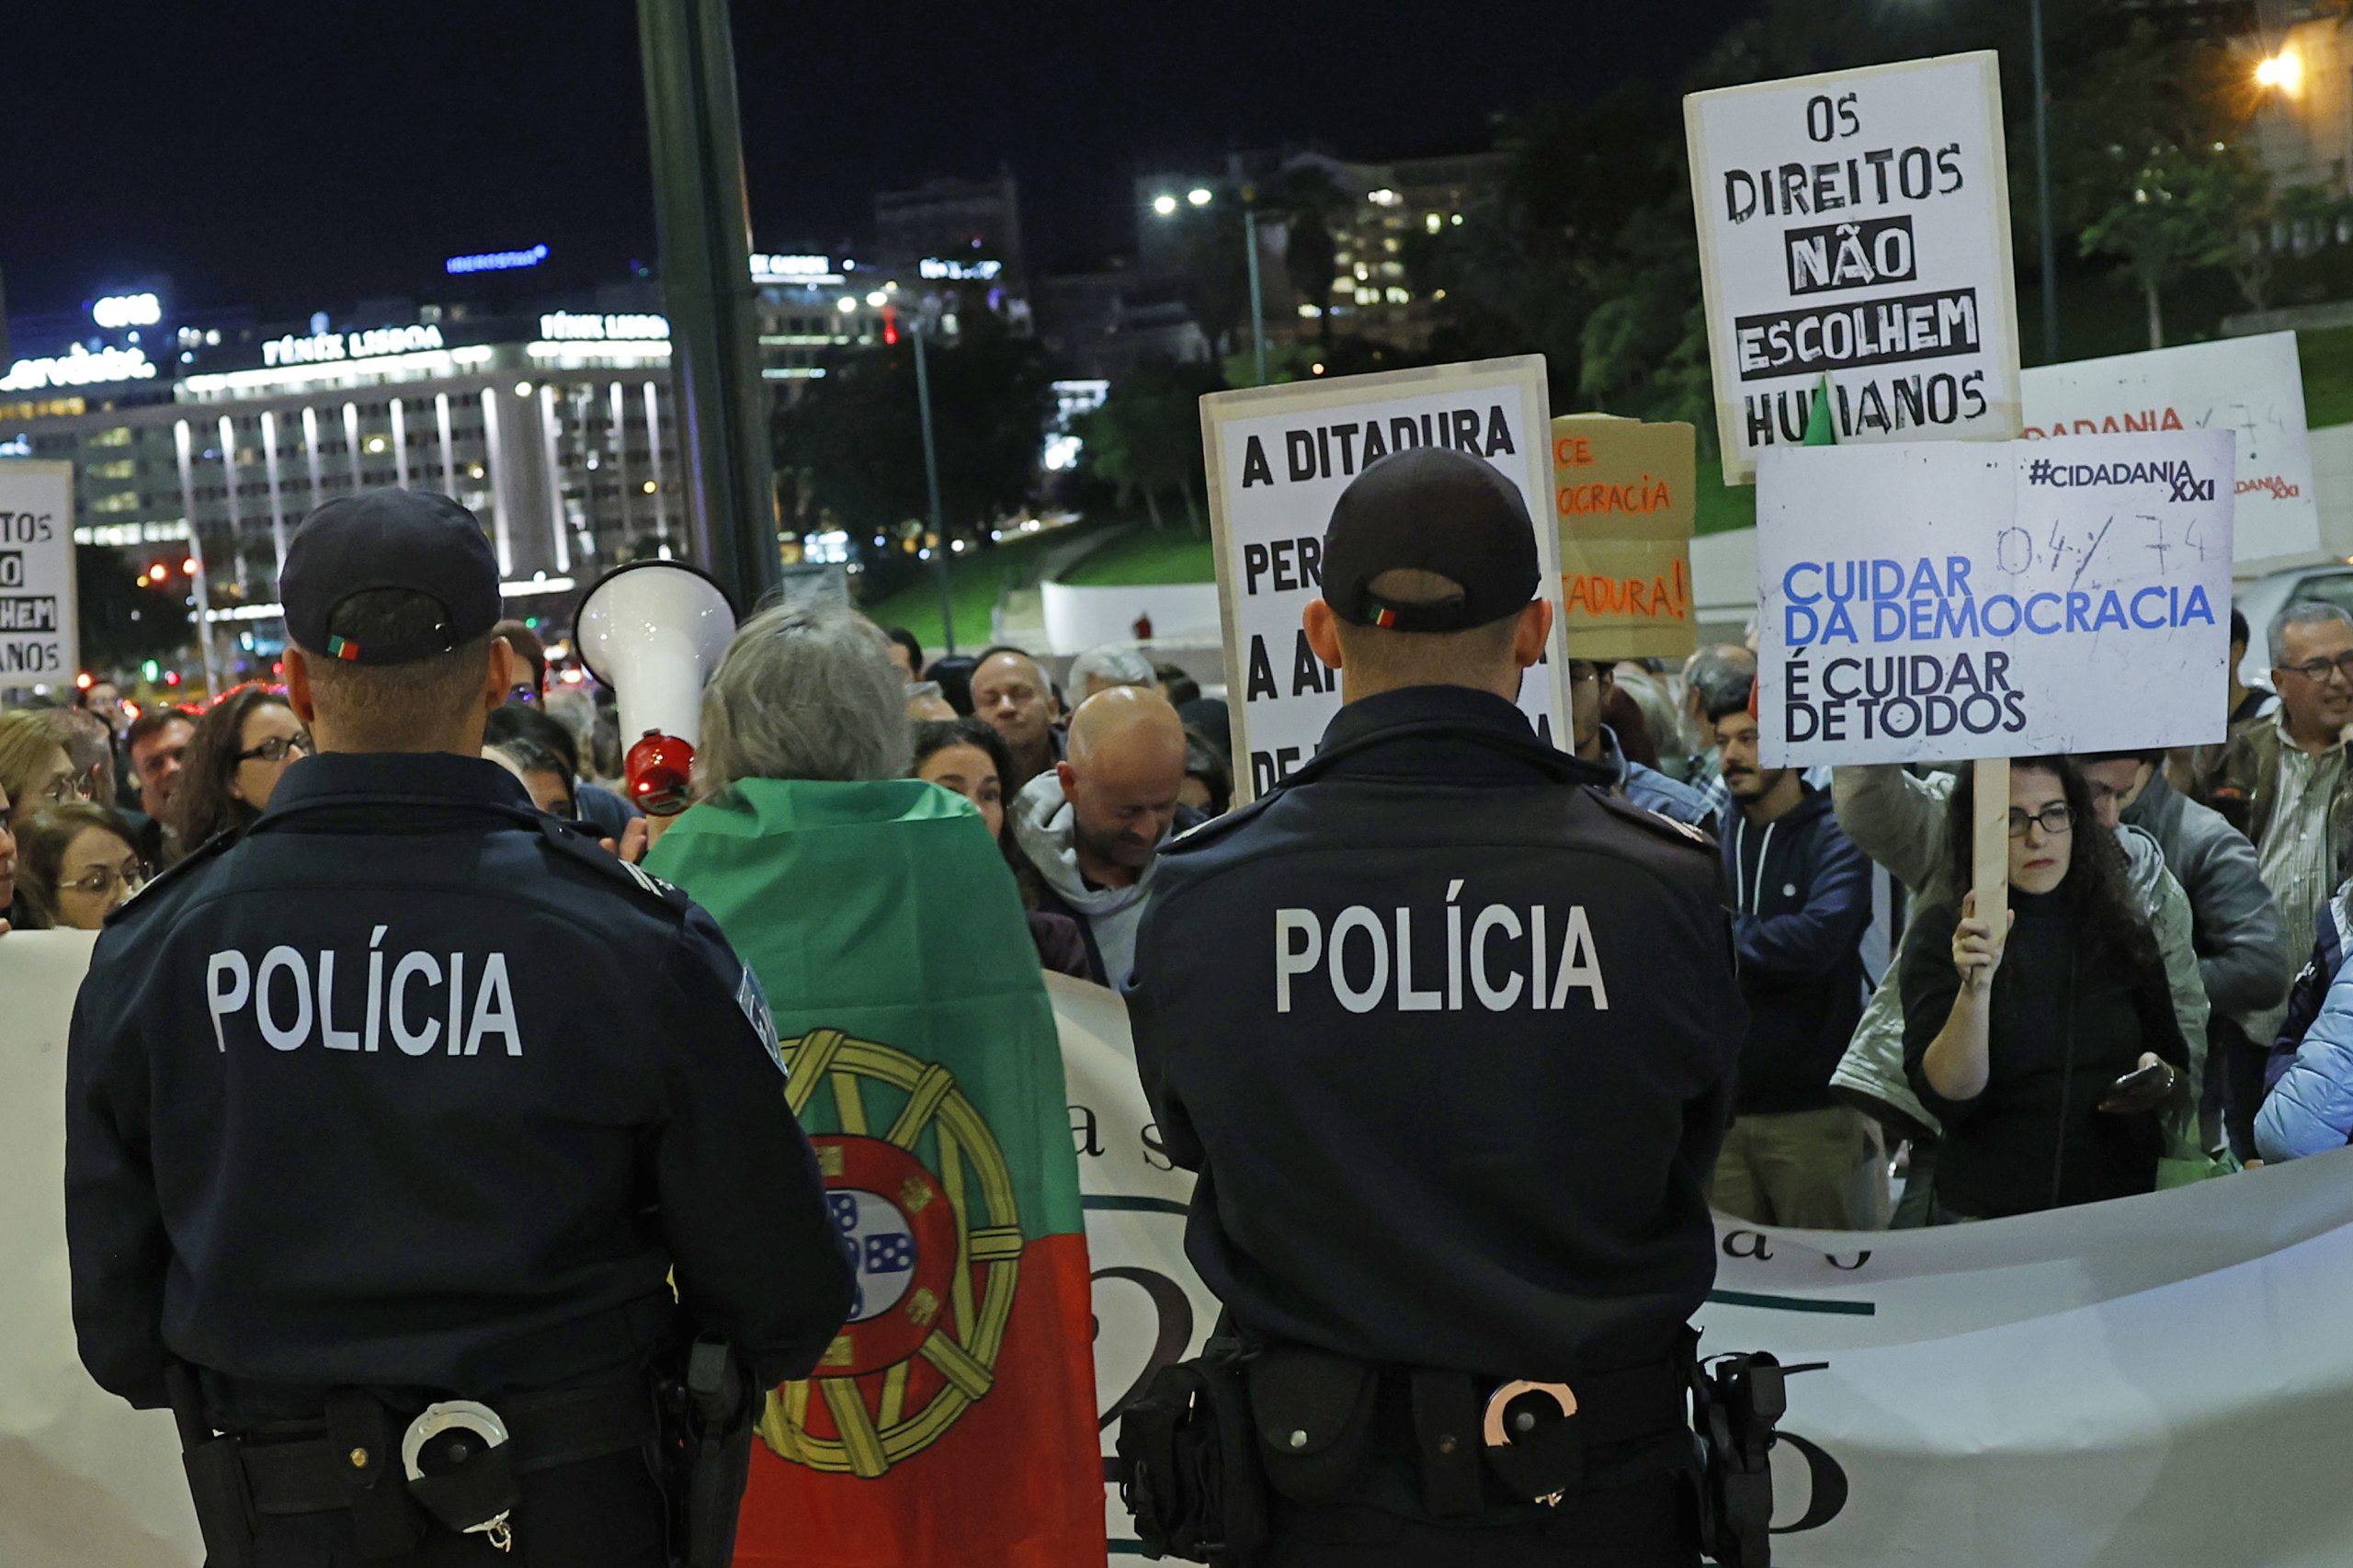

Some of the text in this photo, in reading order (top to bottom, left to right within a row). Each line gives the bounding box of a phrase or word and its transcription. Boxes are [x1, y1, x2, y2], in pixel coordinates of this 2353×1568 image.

[1807, 92, 1860, 142] OS
[1724, 142, 1963, 224] DIREITOS
[1790, 223, 1913, 290] NÃO
[1737, 295, 1978, 372] ESCOLHEM
[1243, 404, 1517, 488] A DITADURA
[2029, 459, 2195, 488] #CIDADANIA
[2168, 479, 2215, 503] XXI
[1782, 556, 1974, 607] CUIDAR
[1784, 585, 2216, 647] DA DEMOCRACIA
[0, 642, 59, 673] NOS
[1247, 634, 1279, 702] A
[1786, 647, 2011, 701] É CUIDAR
[1786, 689, 2028, 744] DE TODOS
[1275, 879, 1609, 1014] POLÍCIA
[206, 925, 523, 1057] POLÍCIA
